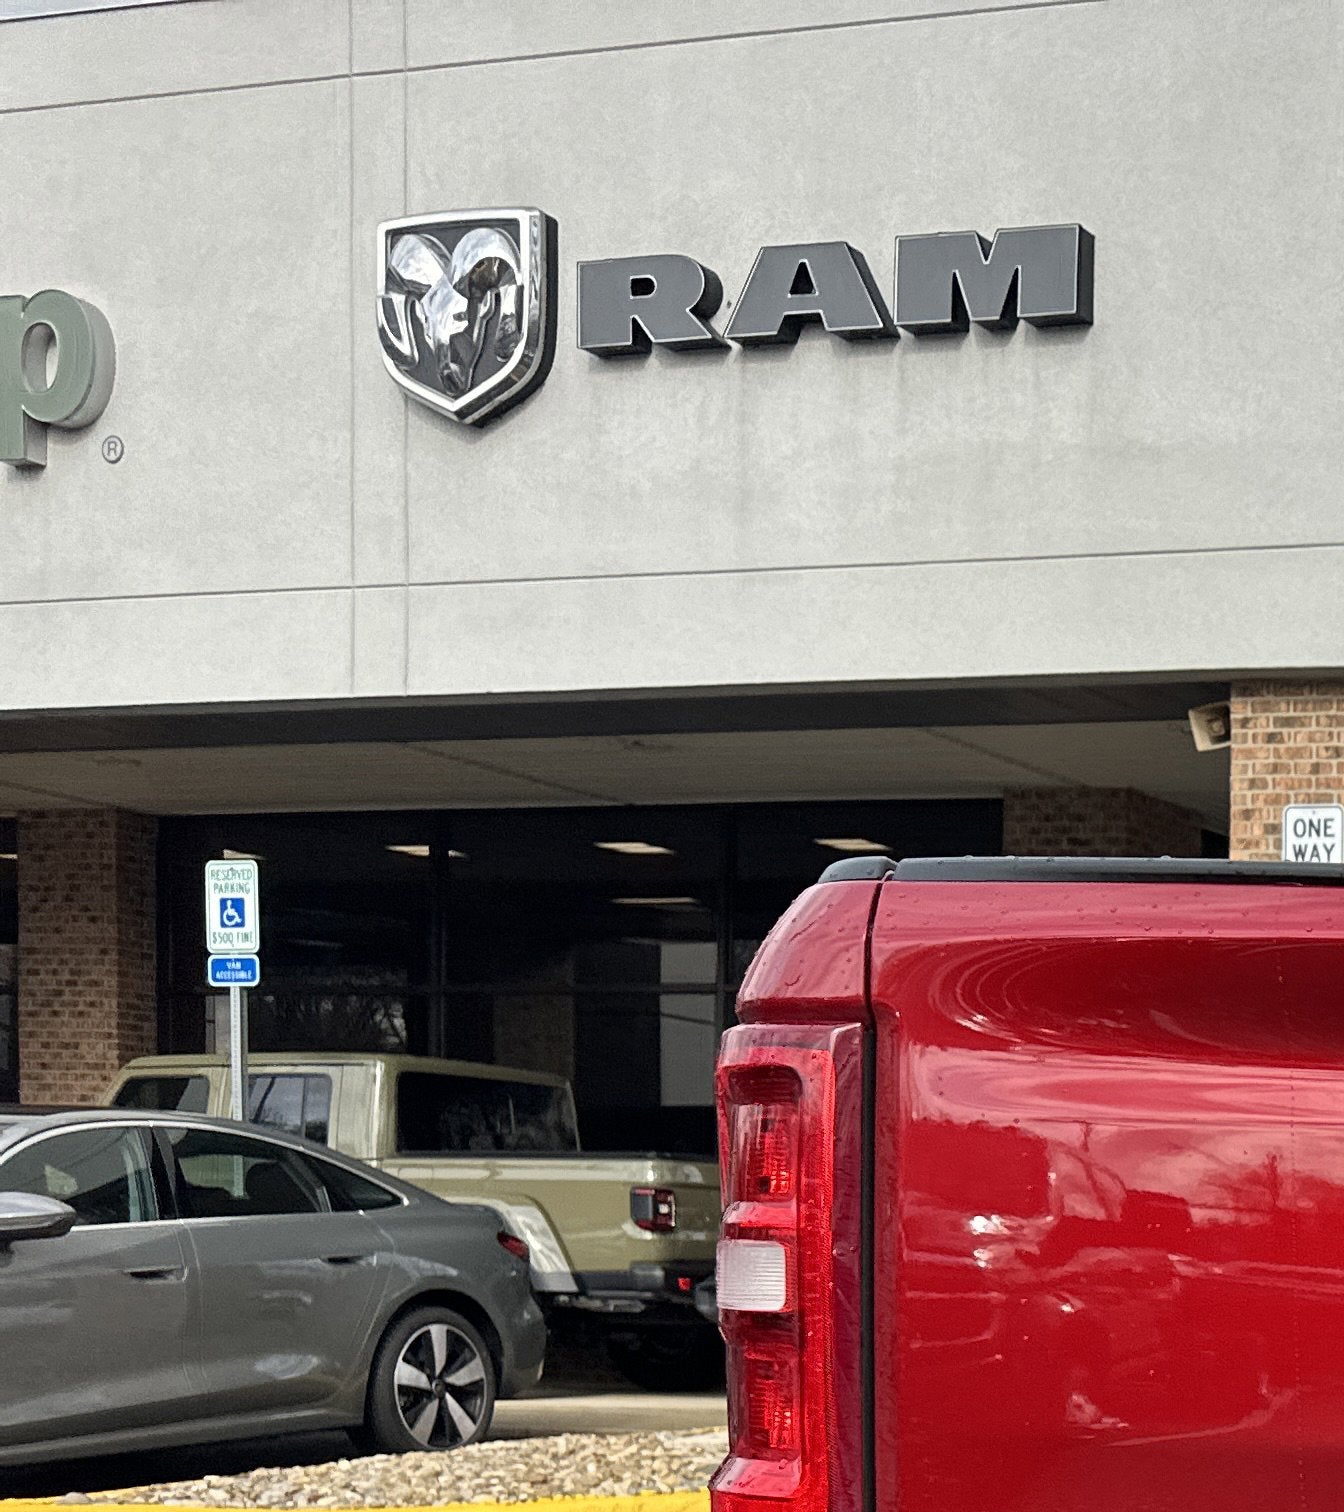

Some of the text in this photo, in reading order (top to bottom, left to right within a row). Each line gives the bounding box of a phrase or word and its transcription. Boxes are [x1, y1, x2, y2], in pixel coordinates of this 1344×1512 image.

[577, 223, 1094, 357] RAM
[1293, 818, 1335, 838] ONE
[1293, 843, 1335, 862] WAY
[210, 868, 253, 881] RESERVED
[213, 882, 251, 895] PARKING
[212, 931, 234, 945] $500
